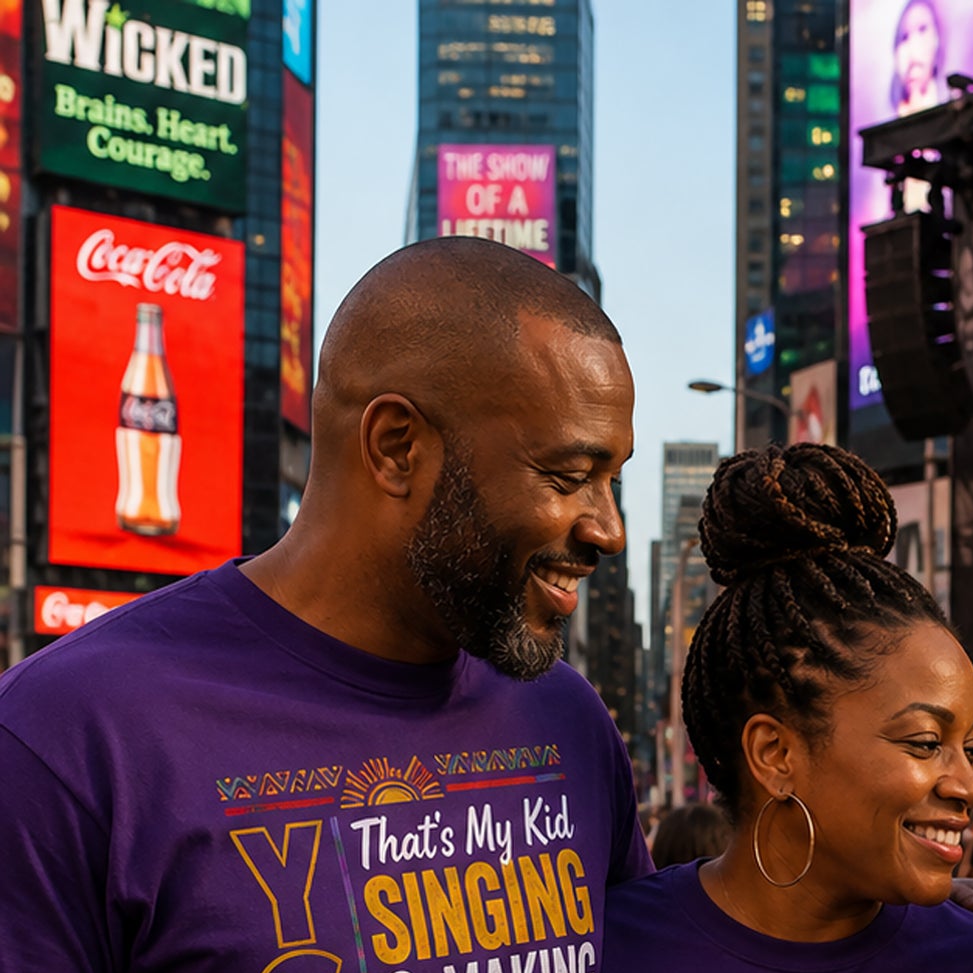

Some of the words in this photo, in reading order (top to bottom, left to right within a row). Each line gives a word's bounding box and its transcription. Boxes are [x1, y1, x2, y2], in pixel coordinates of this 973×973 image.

[55, 84, 153, 135] Brains.
[157, 107, 238, 155] Heart.
[87, 126, 212, 182] Courage.
[444, 153, 483, 181] THE
[486, 153, 550, 182] SHOW
[465, 183, 502, 216] OF
[507, 185, 530, 216] A
[350, 811, 455, 870] That's
[465, 803, 512, 865] My
[523, 794, 575, 847] Kid
[363, 848, 595, 966] SINGING
